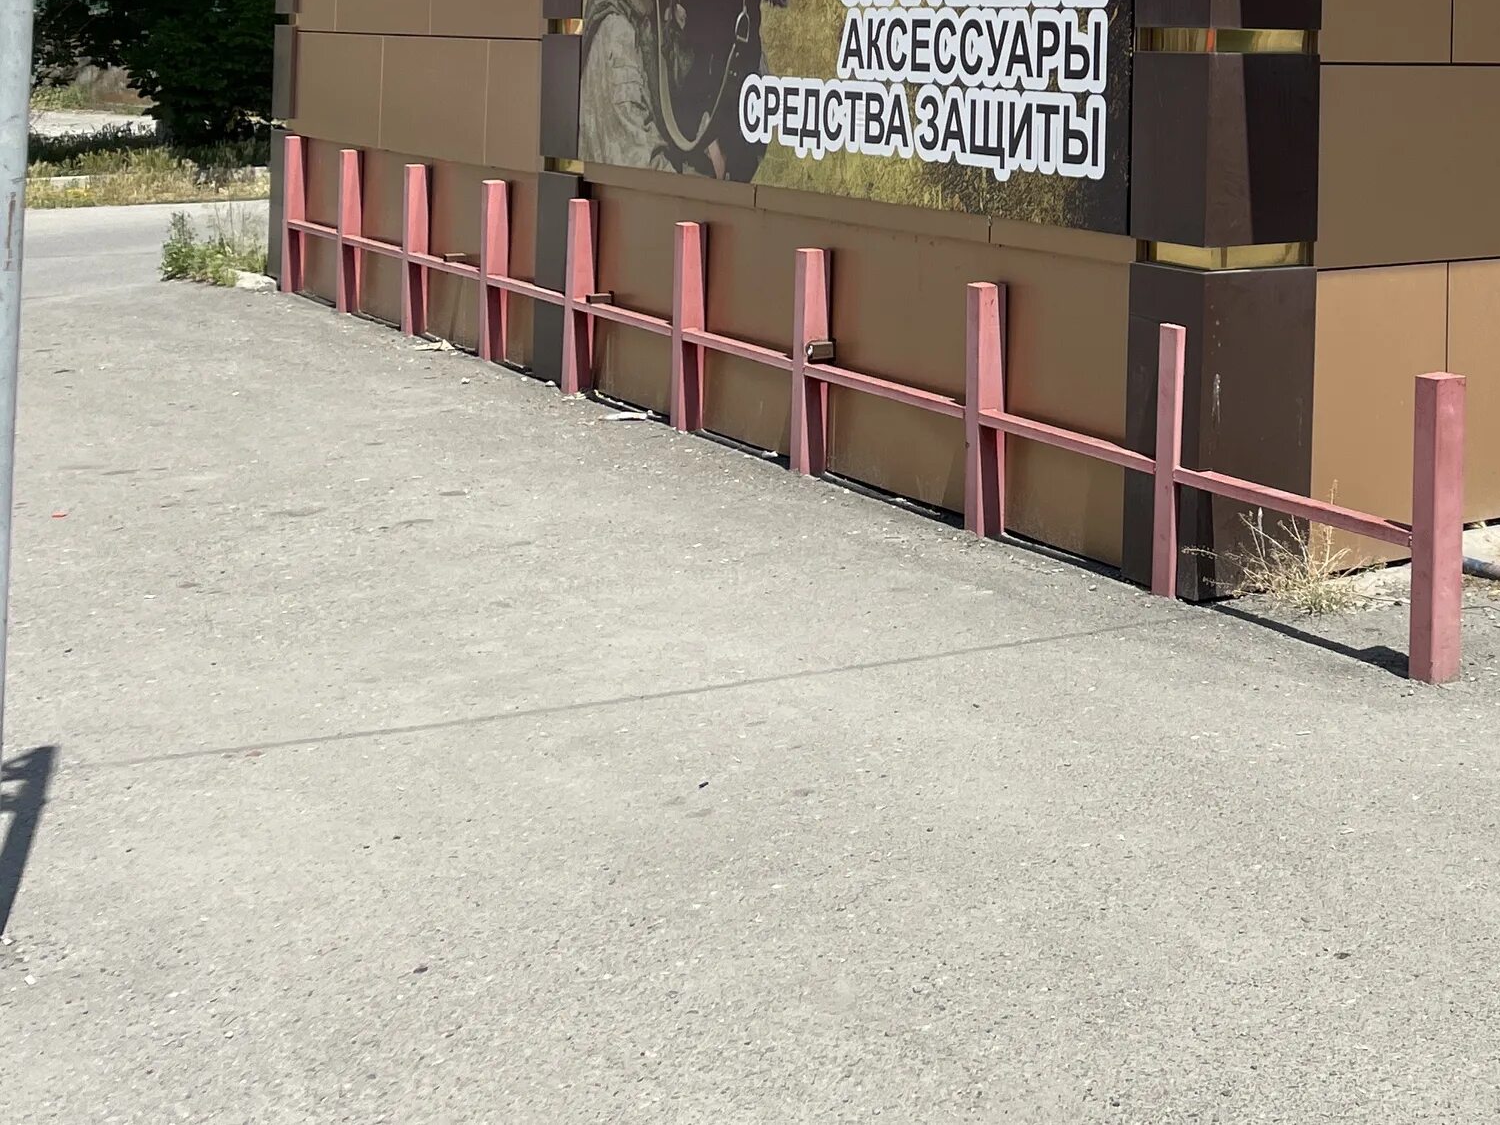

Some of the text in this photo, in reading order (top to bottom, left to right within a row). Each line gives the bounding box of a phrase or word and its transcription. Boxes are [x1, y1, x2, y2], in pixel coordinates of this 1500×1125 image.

[841, 17, 1102, 82] АКСЕССУАРЫ
[742, 83, 1101, 170] СРЕДСТВА ЗАЩИТЫ
